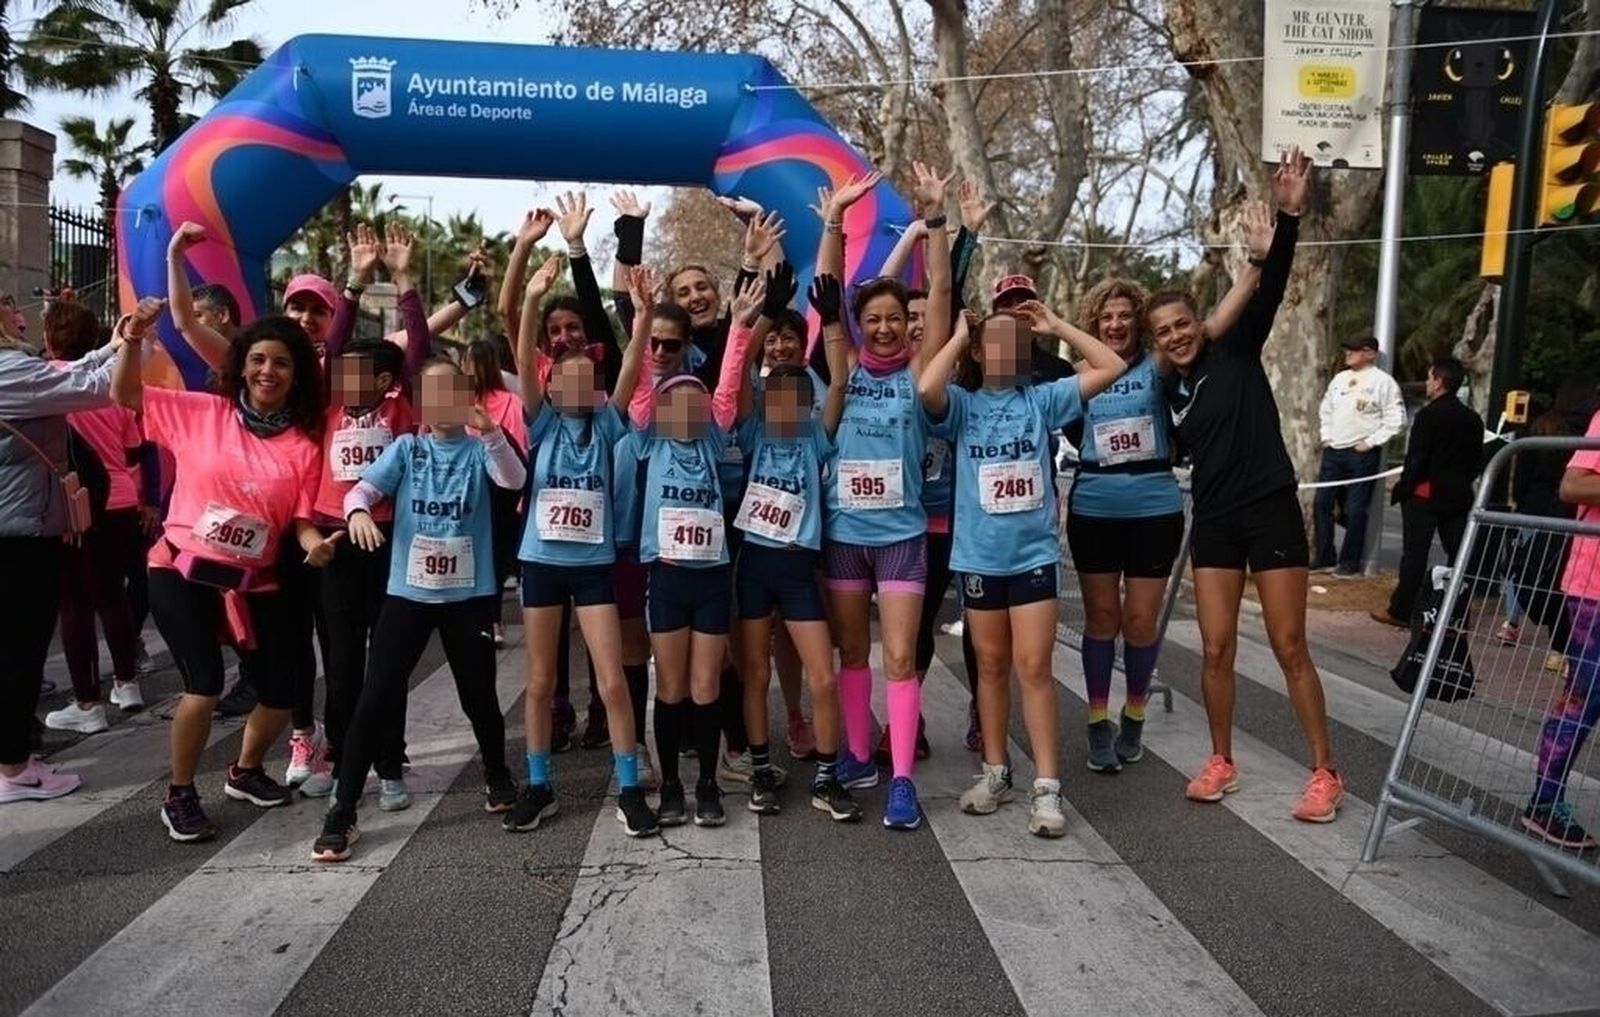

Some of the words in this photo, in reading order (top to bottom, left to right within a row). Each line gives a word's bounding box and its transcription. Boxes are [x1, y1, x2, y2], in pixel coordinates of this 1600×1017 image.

[1284, 24, 1309, 38] THE
[1312, 25, 1334, 39] CAT
[1339, 26, 1374, 40] SHOW
[407, 72, 577, 100] Ayuntamiento
[586, 82, 614, 102] de
[622, 82, 707, 109] Málaga
[407, 98, 445, 117] Área
[448, 101, 467, 118] de
[470, 104, 532, 121] Deporte
[969, 437, 1036, 460] nerja
[1109, 432, 1141, 452] 594
[341, 445, 385, 466] 3947
[850, 476, 886, 496] 595
[993, 477, 1034, 499] 2481
[549, 505, 593, 528] 2763
[748, 500, 792, 529] 2480
[205, 521, 256, 549] 2962
[673, 525, 713, 546] 4161
[424, 555, 458, 576] 991
